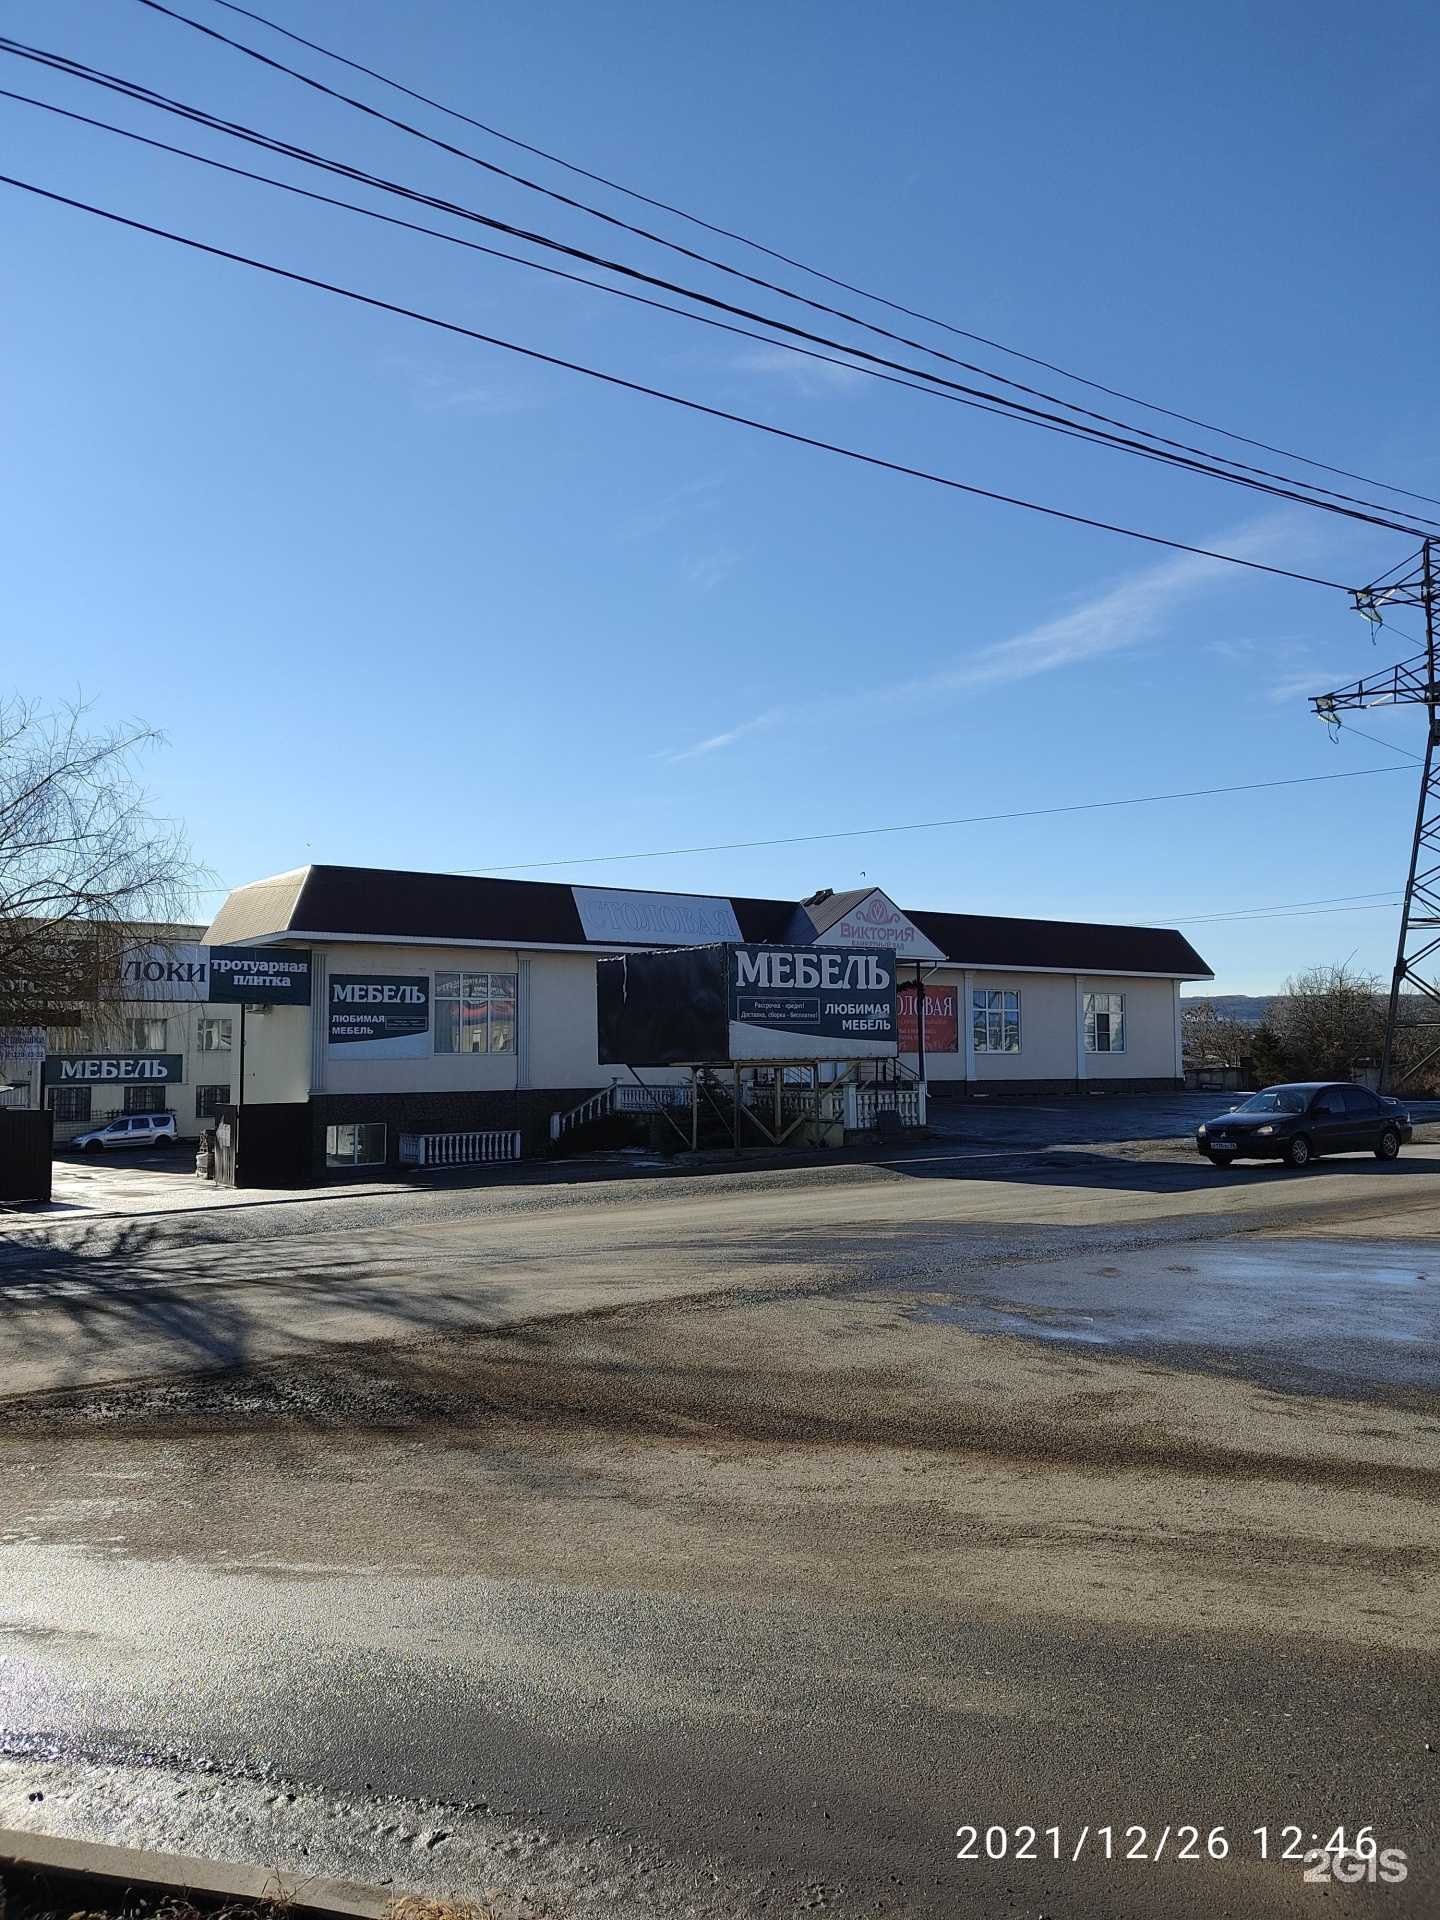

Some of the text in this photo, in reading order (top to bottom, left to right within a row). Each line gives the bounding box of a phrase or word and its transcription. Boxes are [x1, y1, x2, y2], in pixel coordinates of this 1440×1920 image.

[211, 959, 308, 974] тротуарная
[735, 951, 890, 989] МЕБЕЛЬ
[233, 975, 291, 987] плитка
[332, 984, 426, 1004] МЕБЕЛЬ
[825, 1003, 890, 1015] ЛЮБИМАЯ
[331, 1015, 384, 1024] ЛЮБИМАЯ
[842, 1020, 891, 1031] МЕБЕЛЬ
[331, 1027, 374, 1036] МЕБЕЛЬ
[60, 1060, 168, 1079] МЕБЕЛЬ
